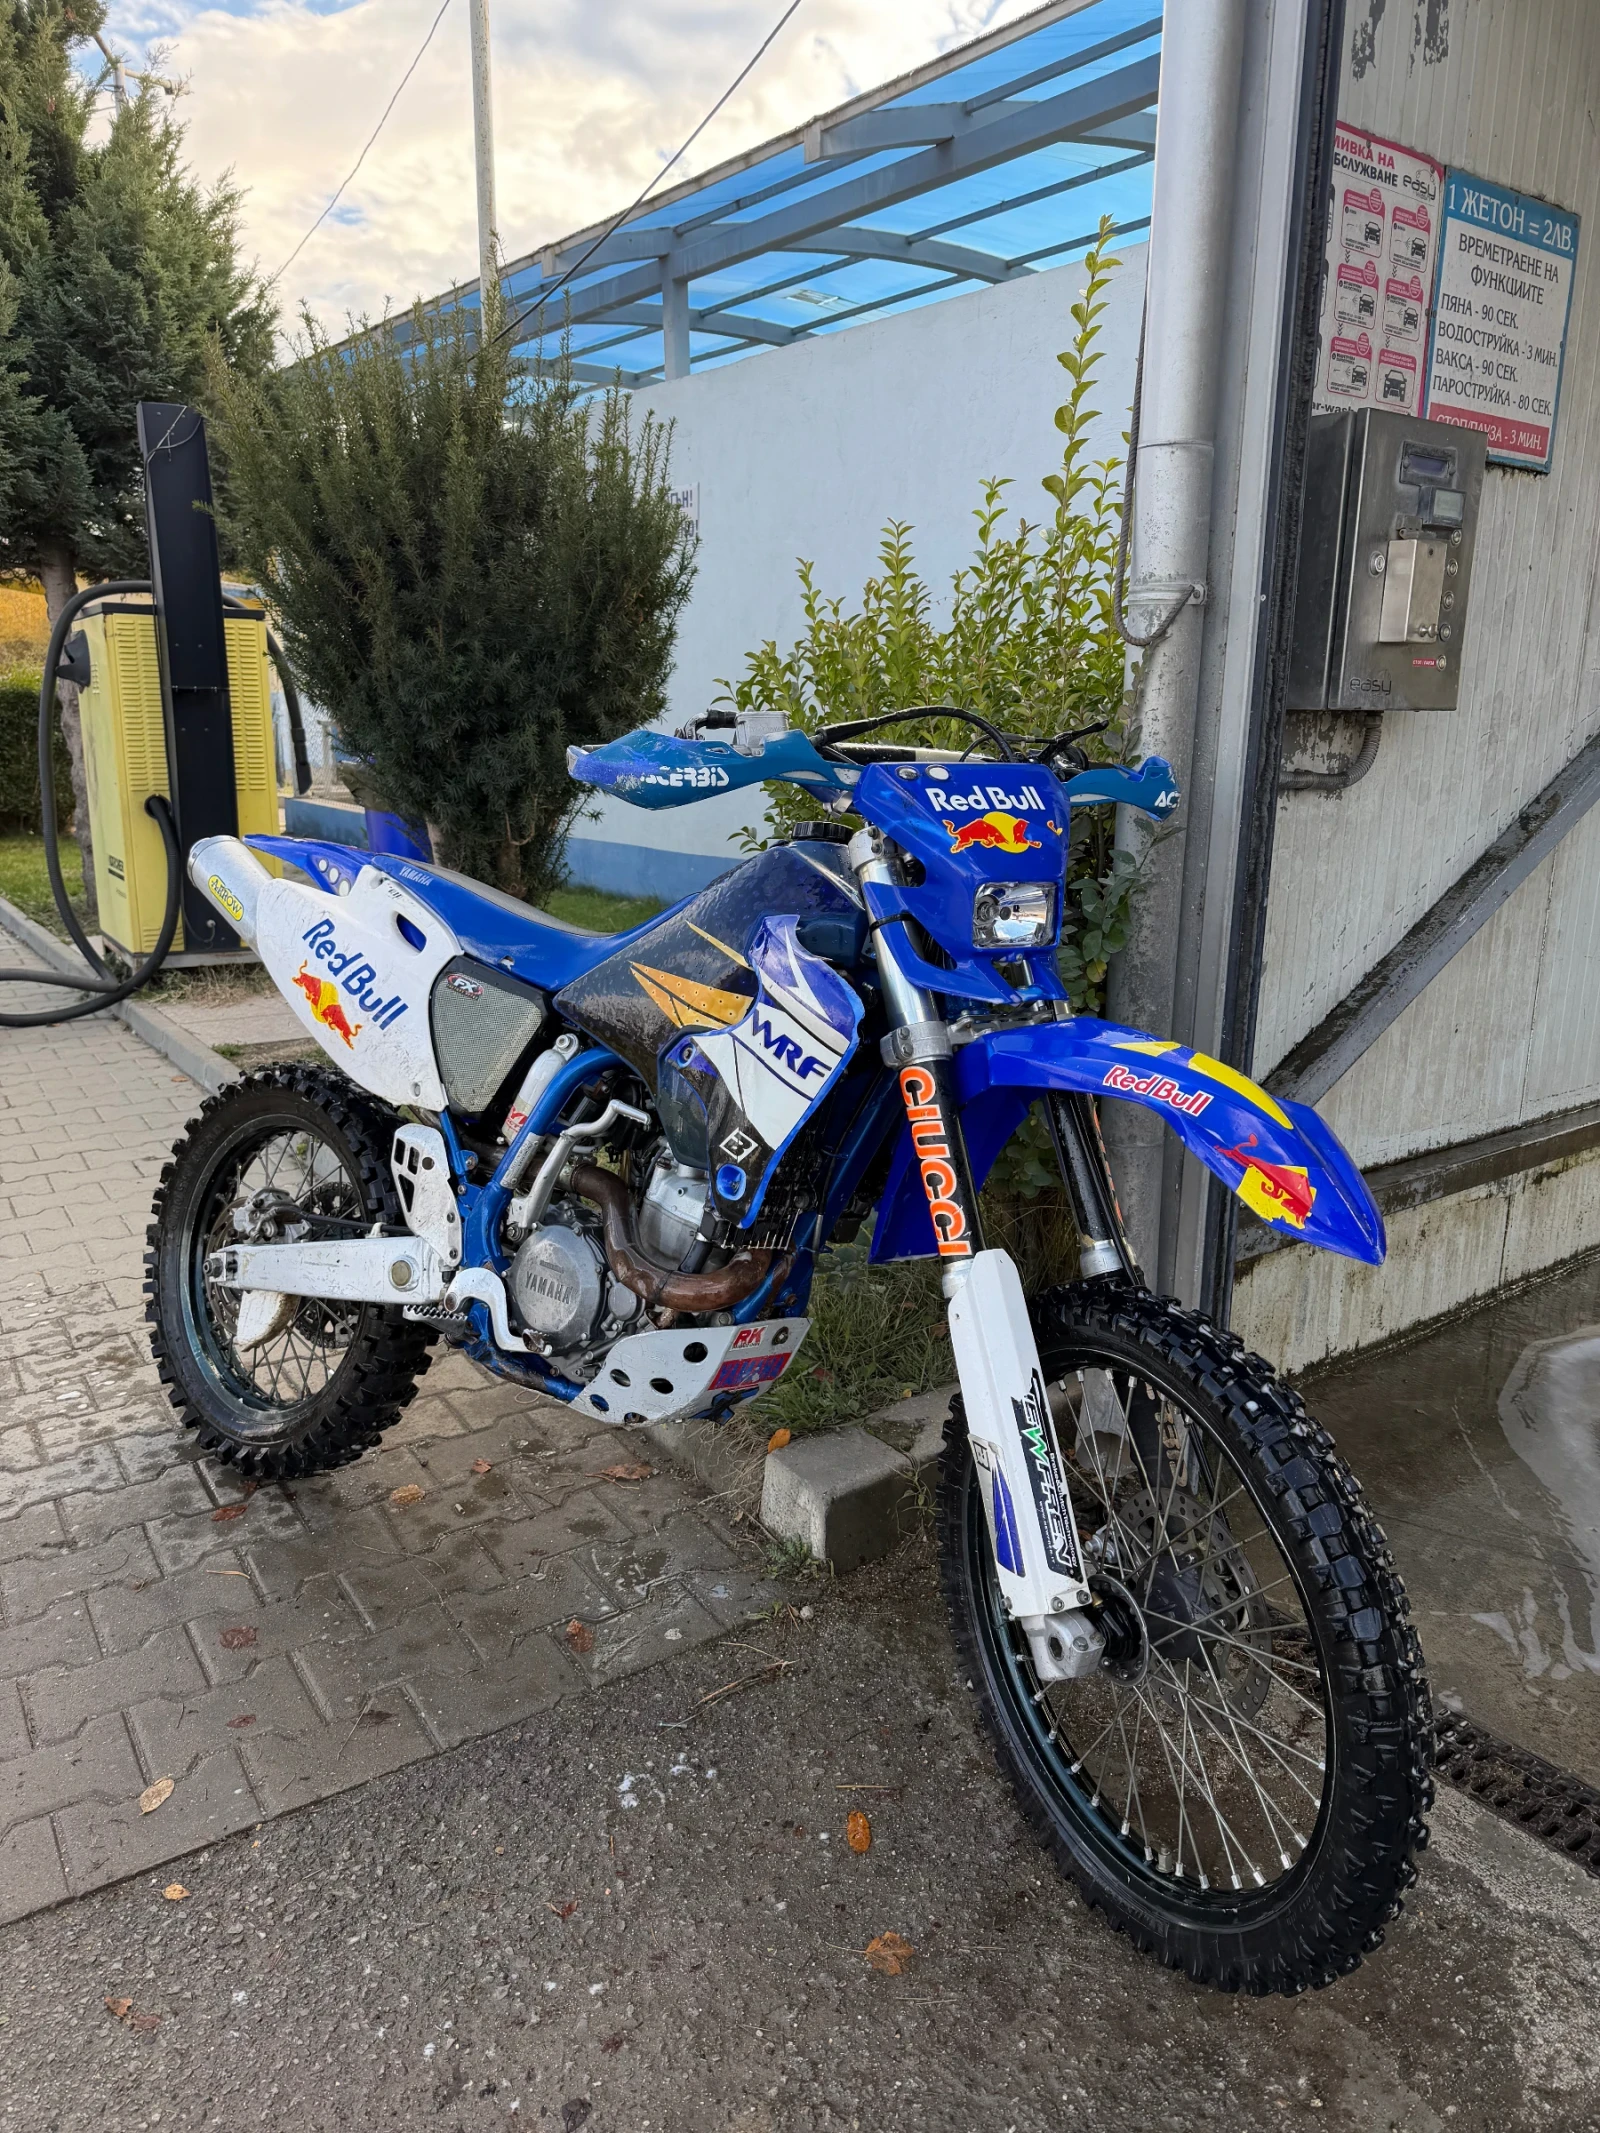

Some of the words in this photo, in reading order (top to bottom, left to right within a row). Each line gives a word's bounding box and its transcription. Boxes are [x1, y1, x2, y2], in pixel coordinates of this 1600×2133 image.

[1378, 152, 1395, 169] НА
[1403, 174, 1436, 200] easy
[1448, 184, 1455, 210] 1
[1461, 187, 1525, 235] ЖЕТОН
[1459, 233, 1542, 277] ВРЕМЕТРАЕНЕ
[1544, 262, 1559, 283] НА
[1471, 265, 1544, 305] ФУНКЦИИТЕ
[1441, 293, 1472, 317] ПЯНА
[1481, 304, 1494, 322] 90
[1496, 309, 1519, 330] СЕК.
[1438, 320, 1520, 357] ВОДОСТРУЙКА
[1526, 345, 1533, 360] 3
[1534, 346, 1558, 368] МИН.
[1435, 348, 1473, 372] ВАКСА
[1481, 359, 1494, 377] 90
[1496, 362, 1519, 383] СЕК.
[1432, 375, 1511, 407] ПАРОСТРУЙКА
[1518, 394, 1530, 411] 80
[1531, 397, 1552, 416] СЕК.
[1509, 430, 1517, 444] 3
[1517, 431, 1542, 450] МИН.
[1350, 677, 1392, 696] easy
[925, 785, 990, 812] Red
[985, 786, 1046, 811] Bull
[399, 865, 434, 886] YAMAHA
[210, 878, 242, 914] ARROW
[302, 918, 364, 977] Red
[341, 963, 409, 1030] Bull
[752, 1008, 832, 1080] WRF
[1103, 1065, 1161, 1095] Red
[1149, 1078, 1214, 1117] Bull
[525, 1271, 573, 1305] YAMAHA
[733, 1326, 766, 1348] RK
